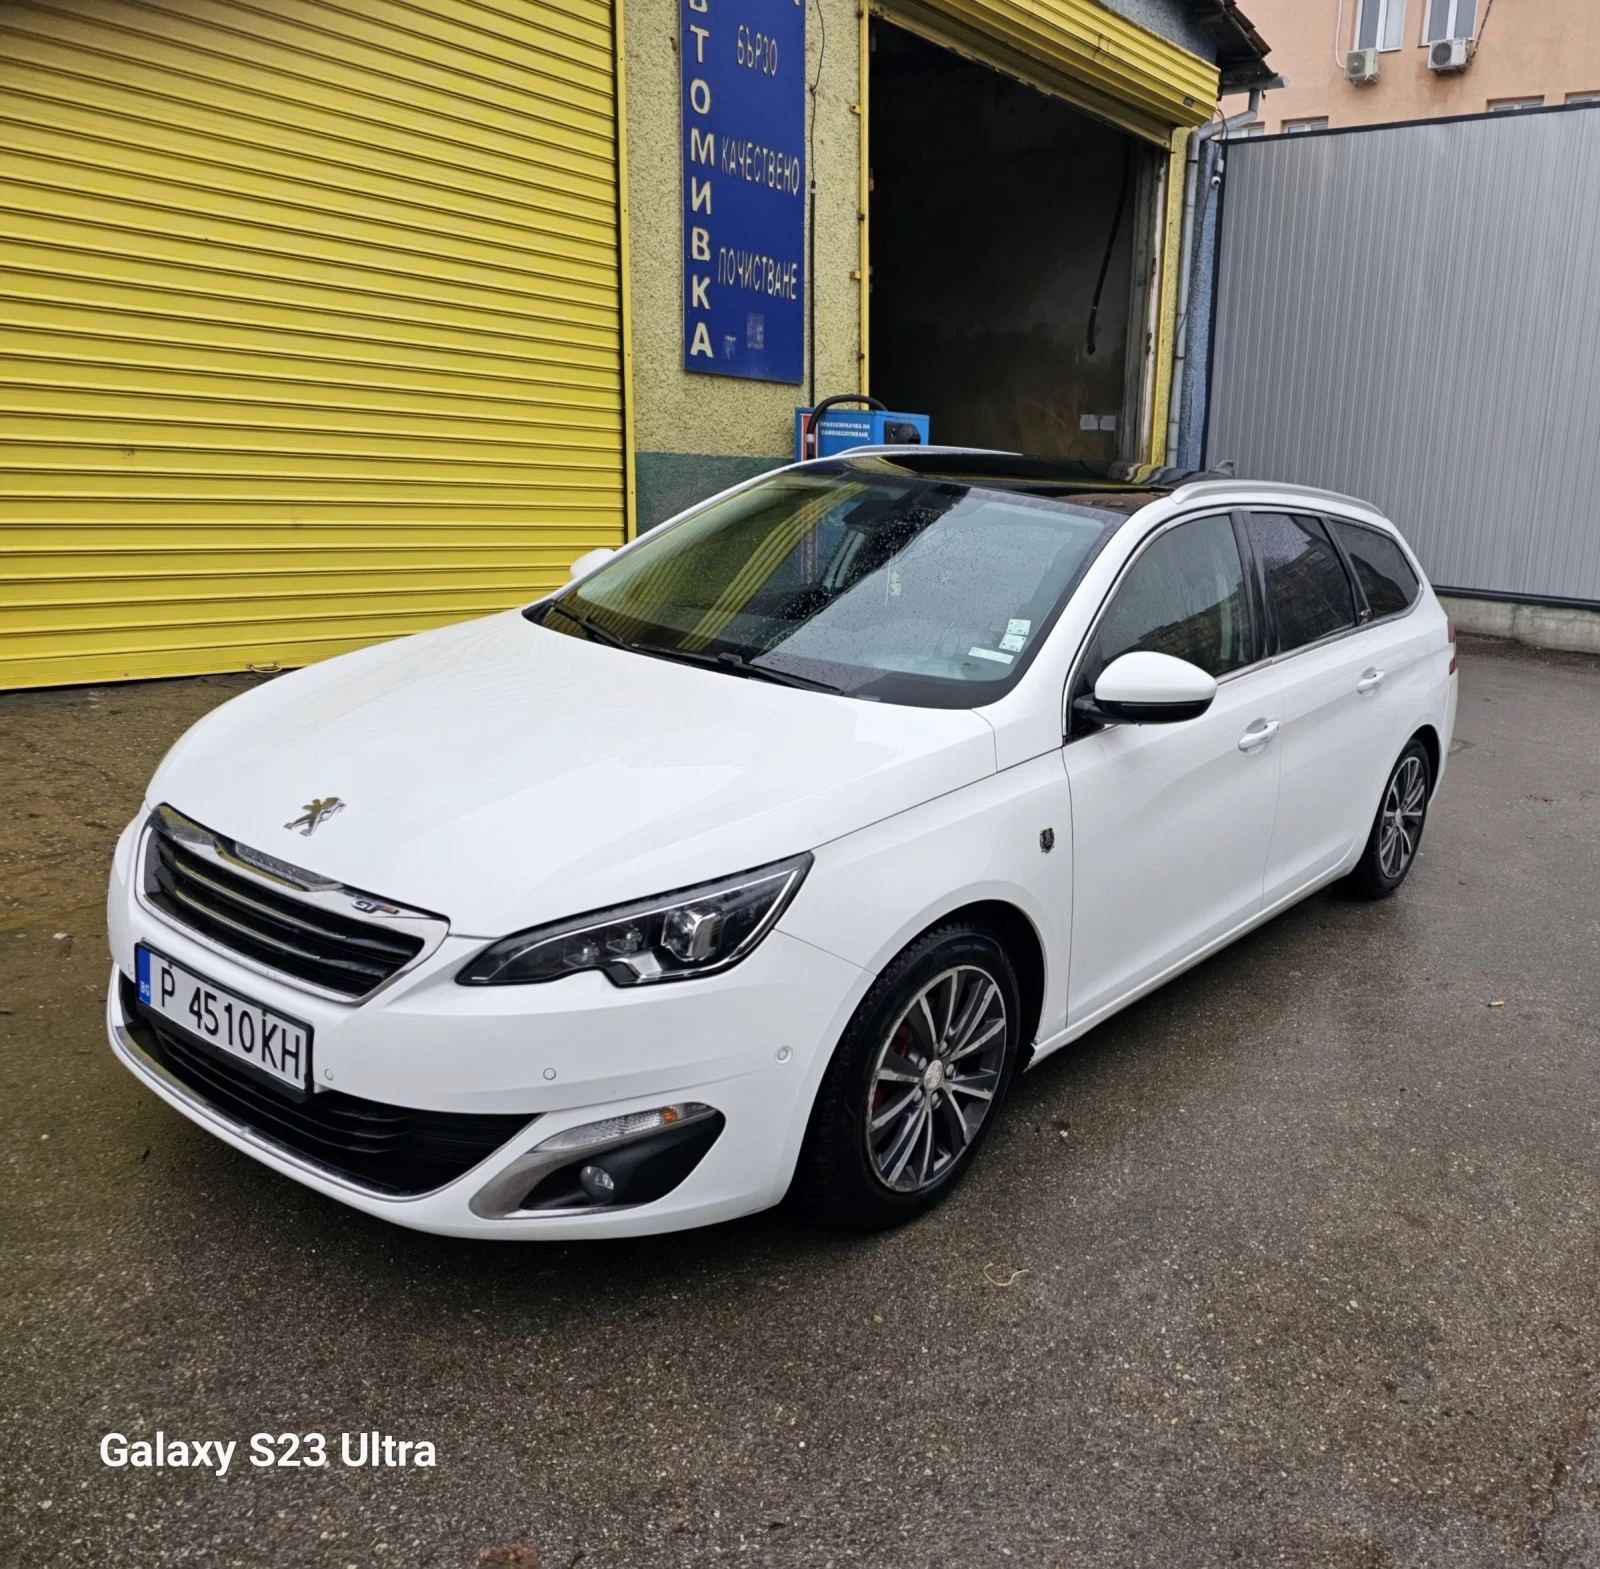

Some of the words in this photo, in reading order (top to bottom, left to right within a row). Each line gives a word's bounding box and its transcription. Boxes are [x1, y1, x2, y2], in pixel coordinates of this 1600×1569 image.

[737, 24, 778, 77] БЪРЗО
[721, 135, 800, 196] КАЧЕСТВЕНО
[718, 247, 798, 300] ПОЧИСТВАНЕ
[140, 980, 150, 997] BG
